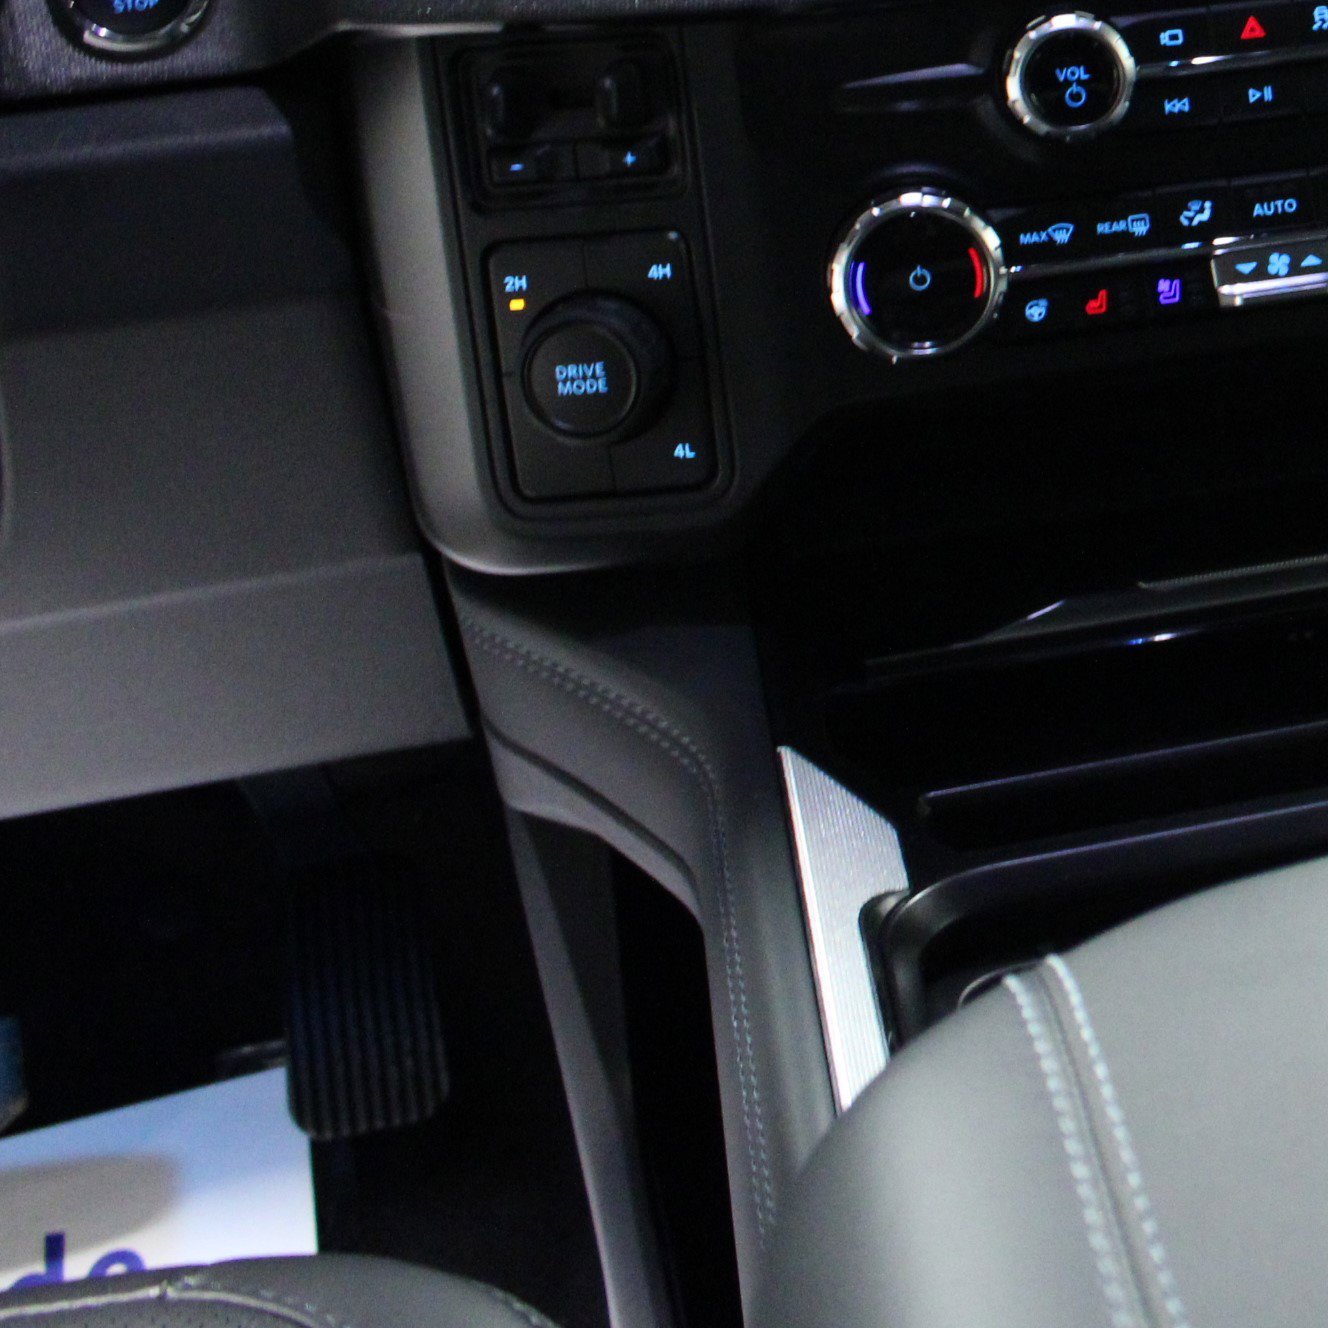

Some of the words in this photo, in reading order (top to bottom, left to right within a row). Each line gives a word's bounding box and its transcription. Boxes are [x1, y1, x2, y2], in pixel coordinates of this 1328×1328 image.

[1055, 65, 1092, 83] VOL
[1252, 198, 1298, 218] AUTO
[1096, 219, 1129, 235] REAR
[1019, 230, 1050, 245] MAX
[647, 263, 673, 280] 4H
[504, 274, 527, 293] 2H
[555, 360, 605, 380] DRIVE
[557, 376, 608, 396] MODE
[673, 442, 696, 459] 4L
